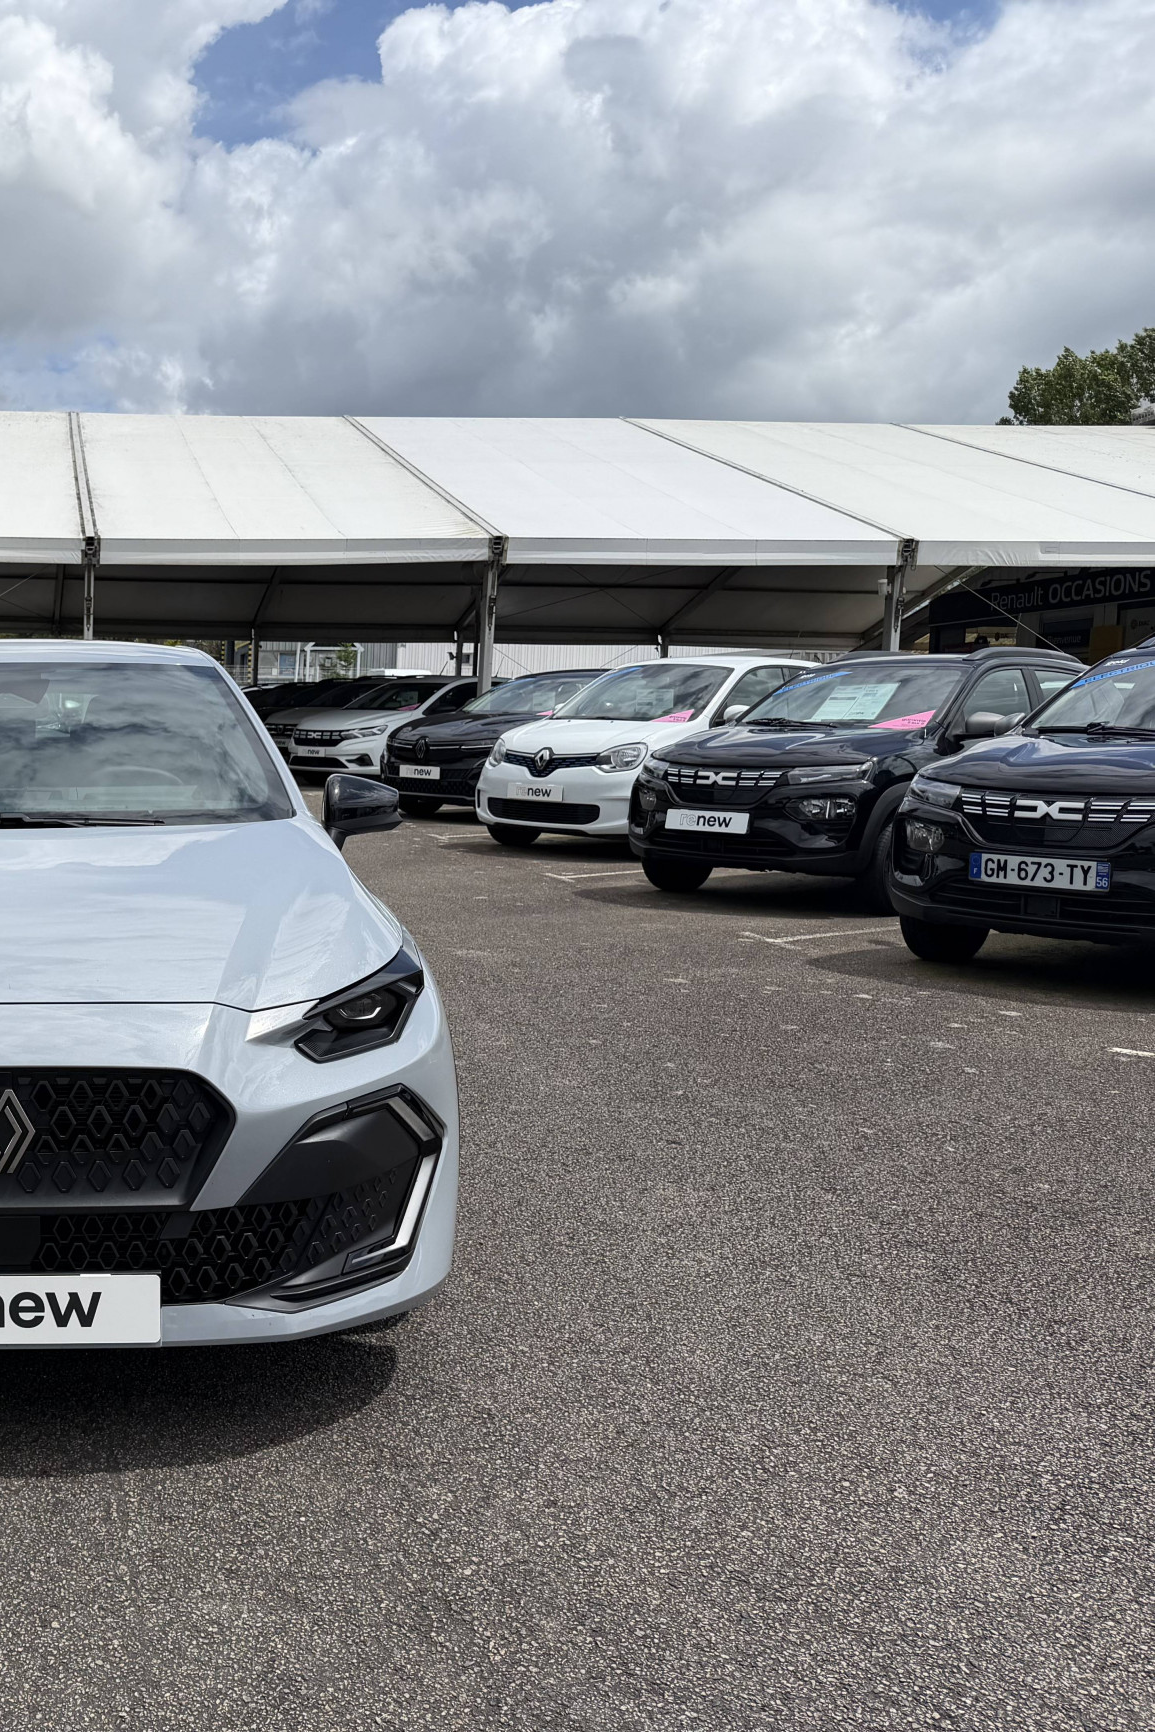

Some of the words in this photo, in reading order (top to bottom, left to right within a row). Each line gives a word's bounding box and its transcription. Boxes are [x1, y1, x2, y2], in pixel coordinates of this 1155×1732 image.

[990, 585, 1044, 611] Renault
[1048, 570, 1151, 604] OCCASIONS
[679, 813, 733, 828] renew
[983, 857, 1093, 886] GM-673-TY
[1096, 877, 1108, 888] 56
